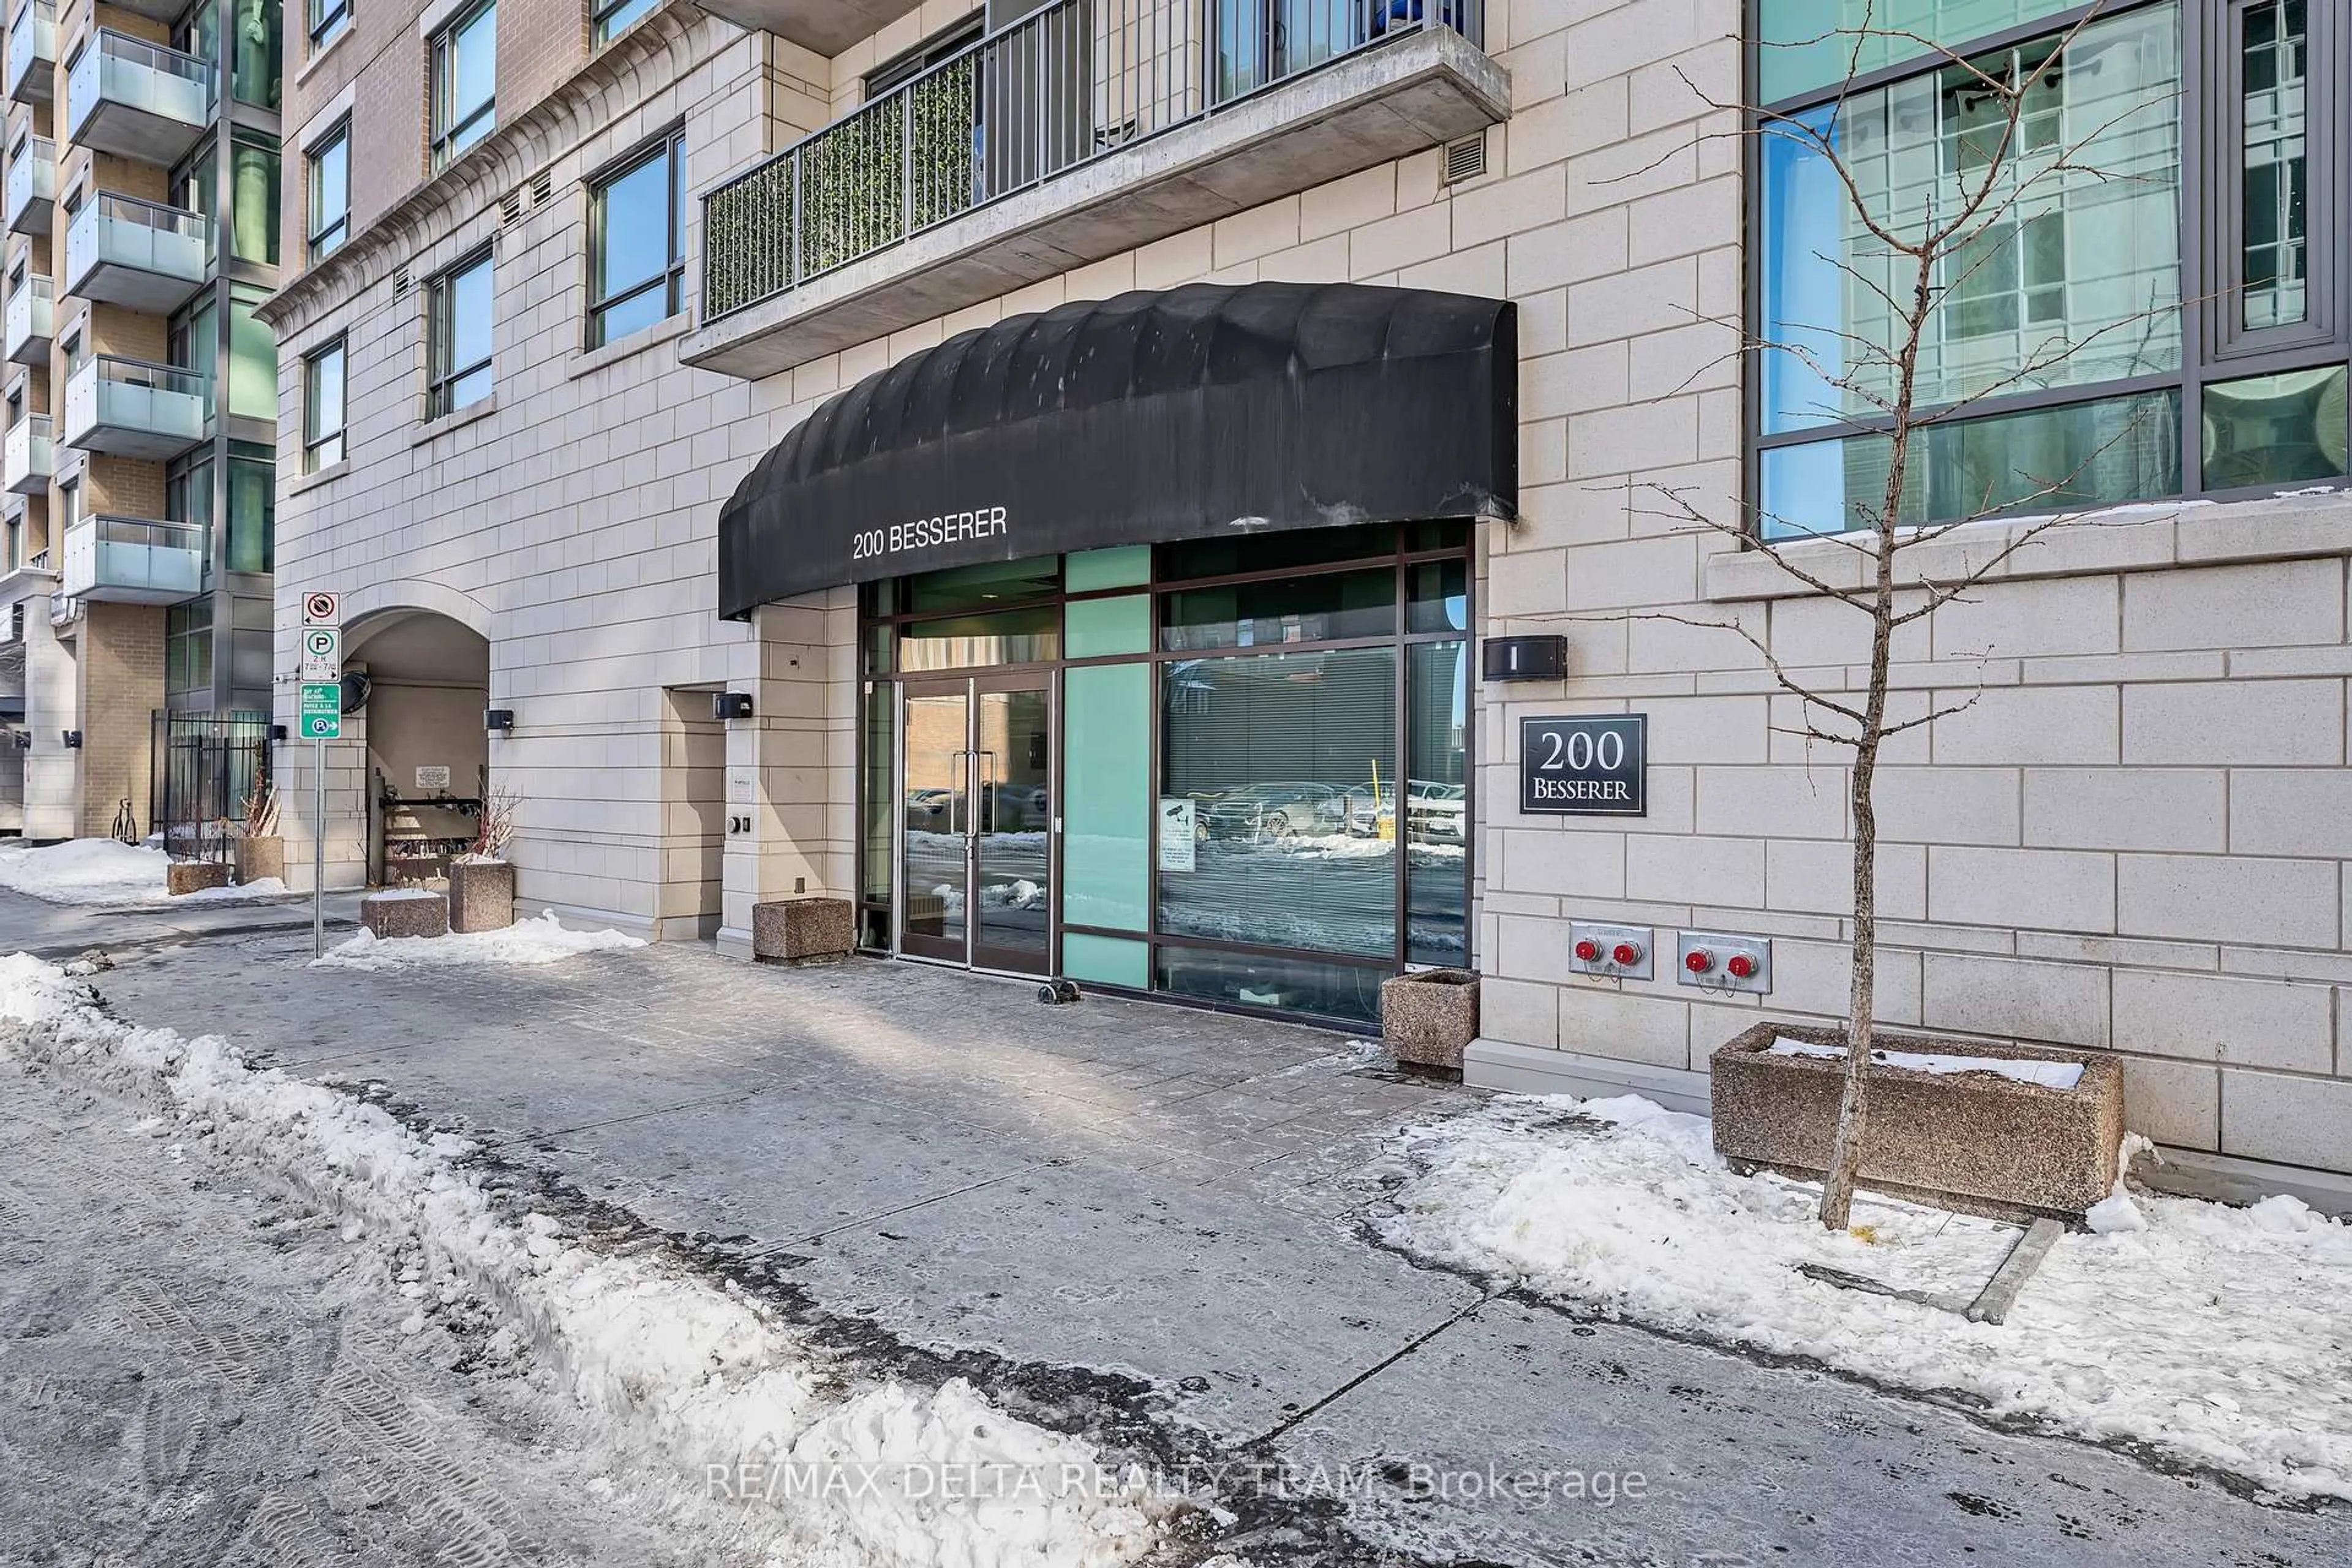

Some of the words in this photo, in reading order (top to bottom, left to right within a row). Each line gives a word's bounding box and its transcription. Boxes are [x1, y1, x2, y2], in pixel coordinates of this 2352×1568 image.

[853, 529, 884, 559] 200
[890, 506, 1007, 552] BESSERER
[316, 636, 328, 650] P
[1540, 731, 1624, 770] 200
[1532, 777, 1632, 800] BESSERER
